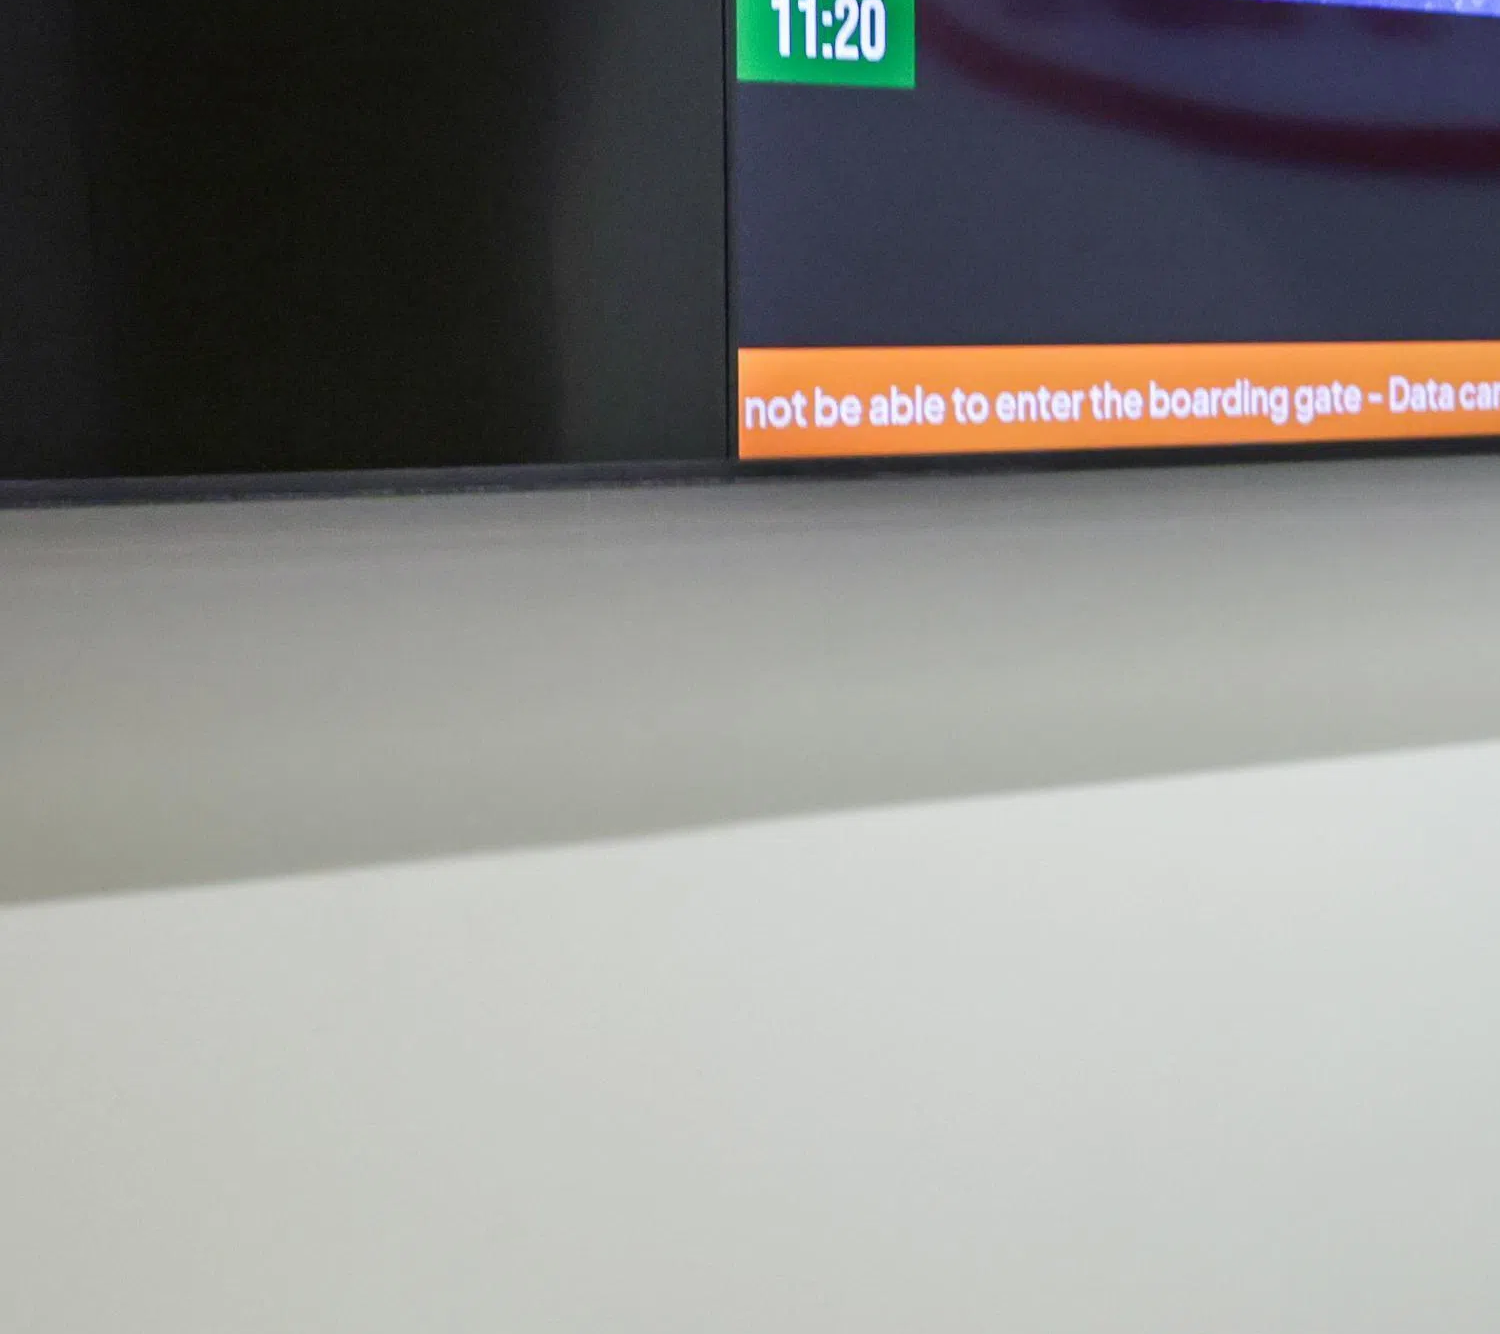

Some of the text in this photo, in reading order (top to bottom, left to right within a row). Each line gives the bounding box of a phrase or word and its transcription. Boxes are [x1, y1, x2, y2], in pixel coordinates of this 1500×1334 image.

[744, 390, 808, 429] not
[814, 387, 863, 427] be
[868, 385, 946, 426] able
[951, 387, 991, 424] to
[995, 386, 1086, 423] enter
[1089, 381, 1144, 421] the
[1148, 378, 1291, 425] boarding
[1294, 381, 1363, 425] gate
[1388, 375, 1456, 413] Data
